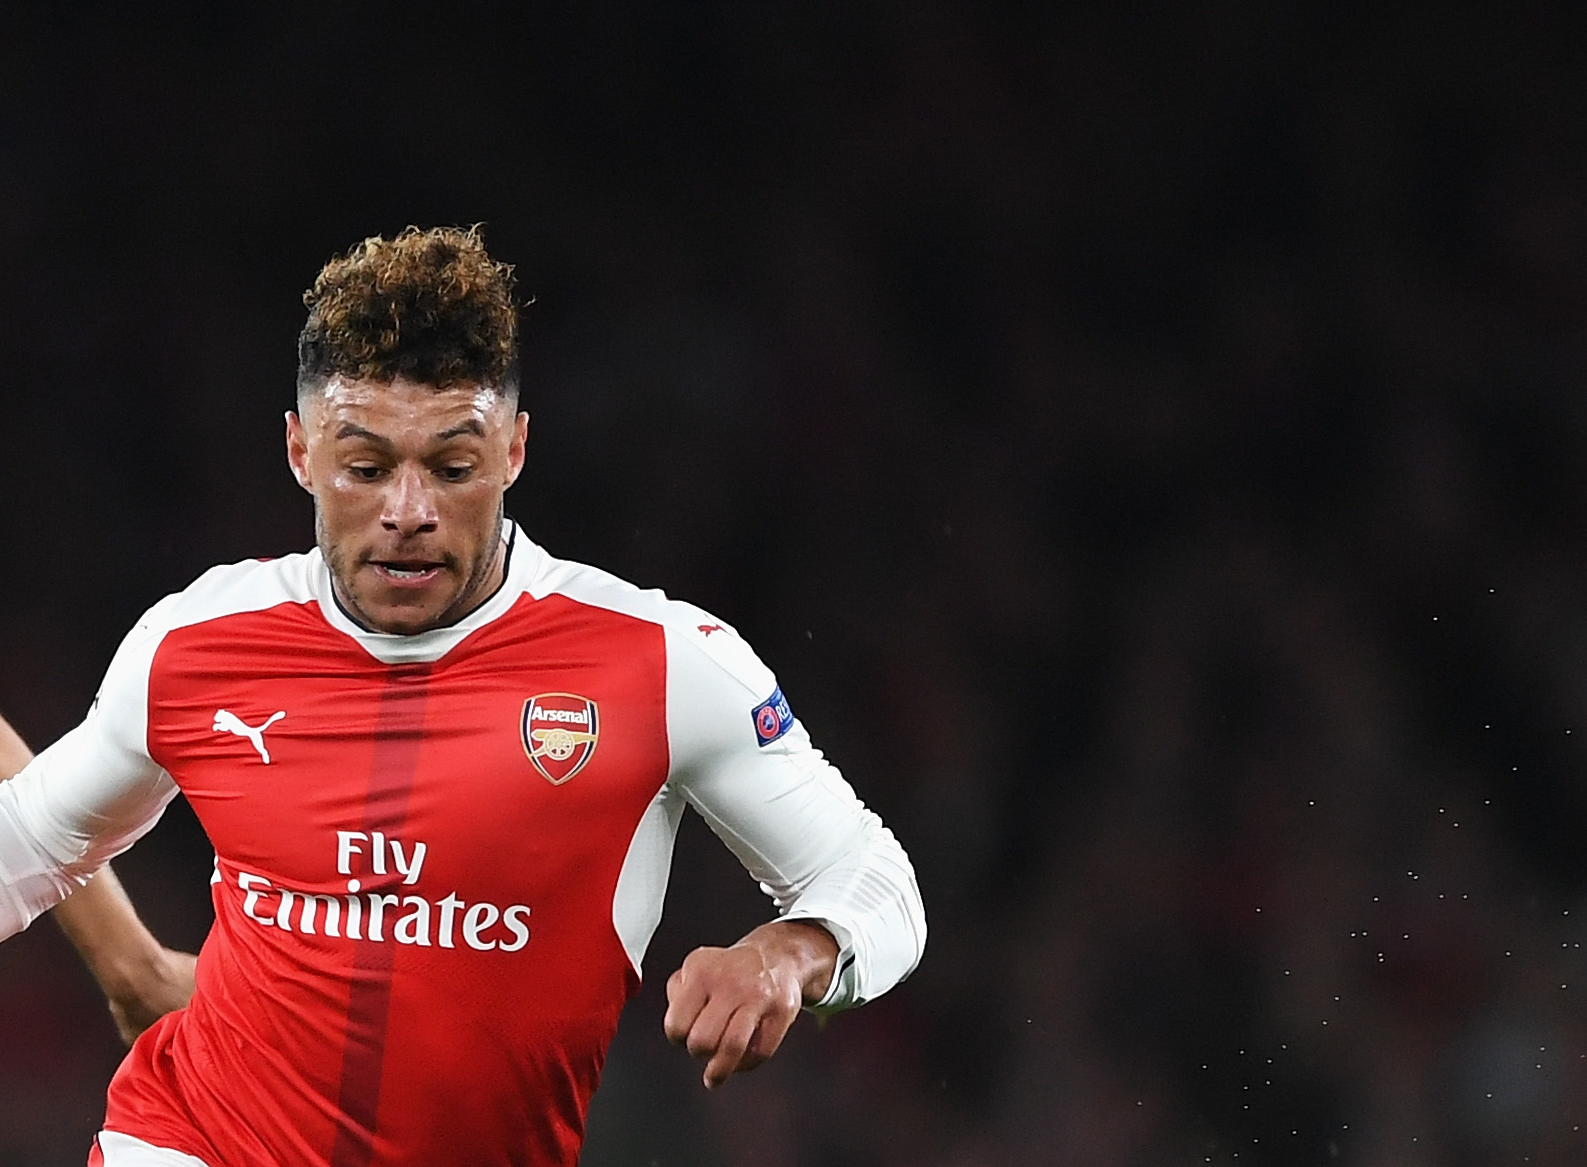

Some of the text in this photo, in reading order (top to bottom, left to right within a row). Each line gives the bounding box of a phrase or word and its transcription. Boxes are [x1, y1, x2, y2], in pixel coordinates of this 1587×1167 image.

[531, 706, 589, 725] Arsenal
[336, 830, 427, 885] Fly
[238, 878, 531, 952] Emirates
